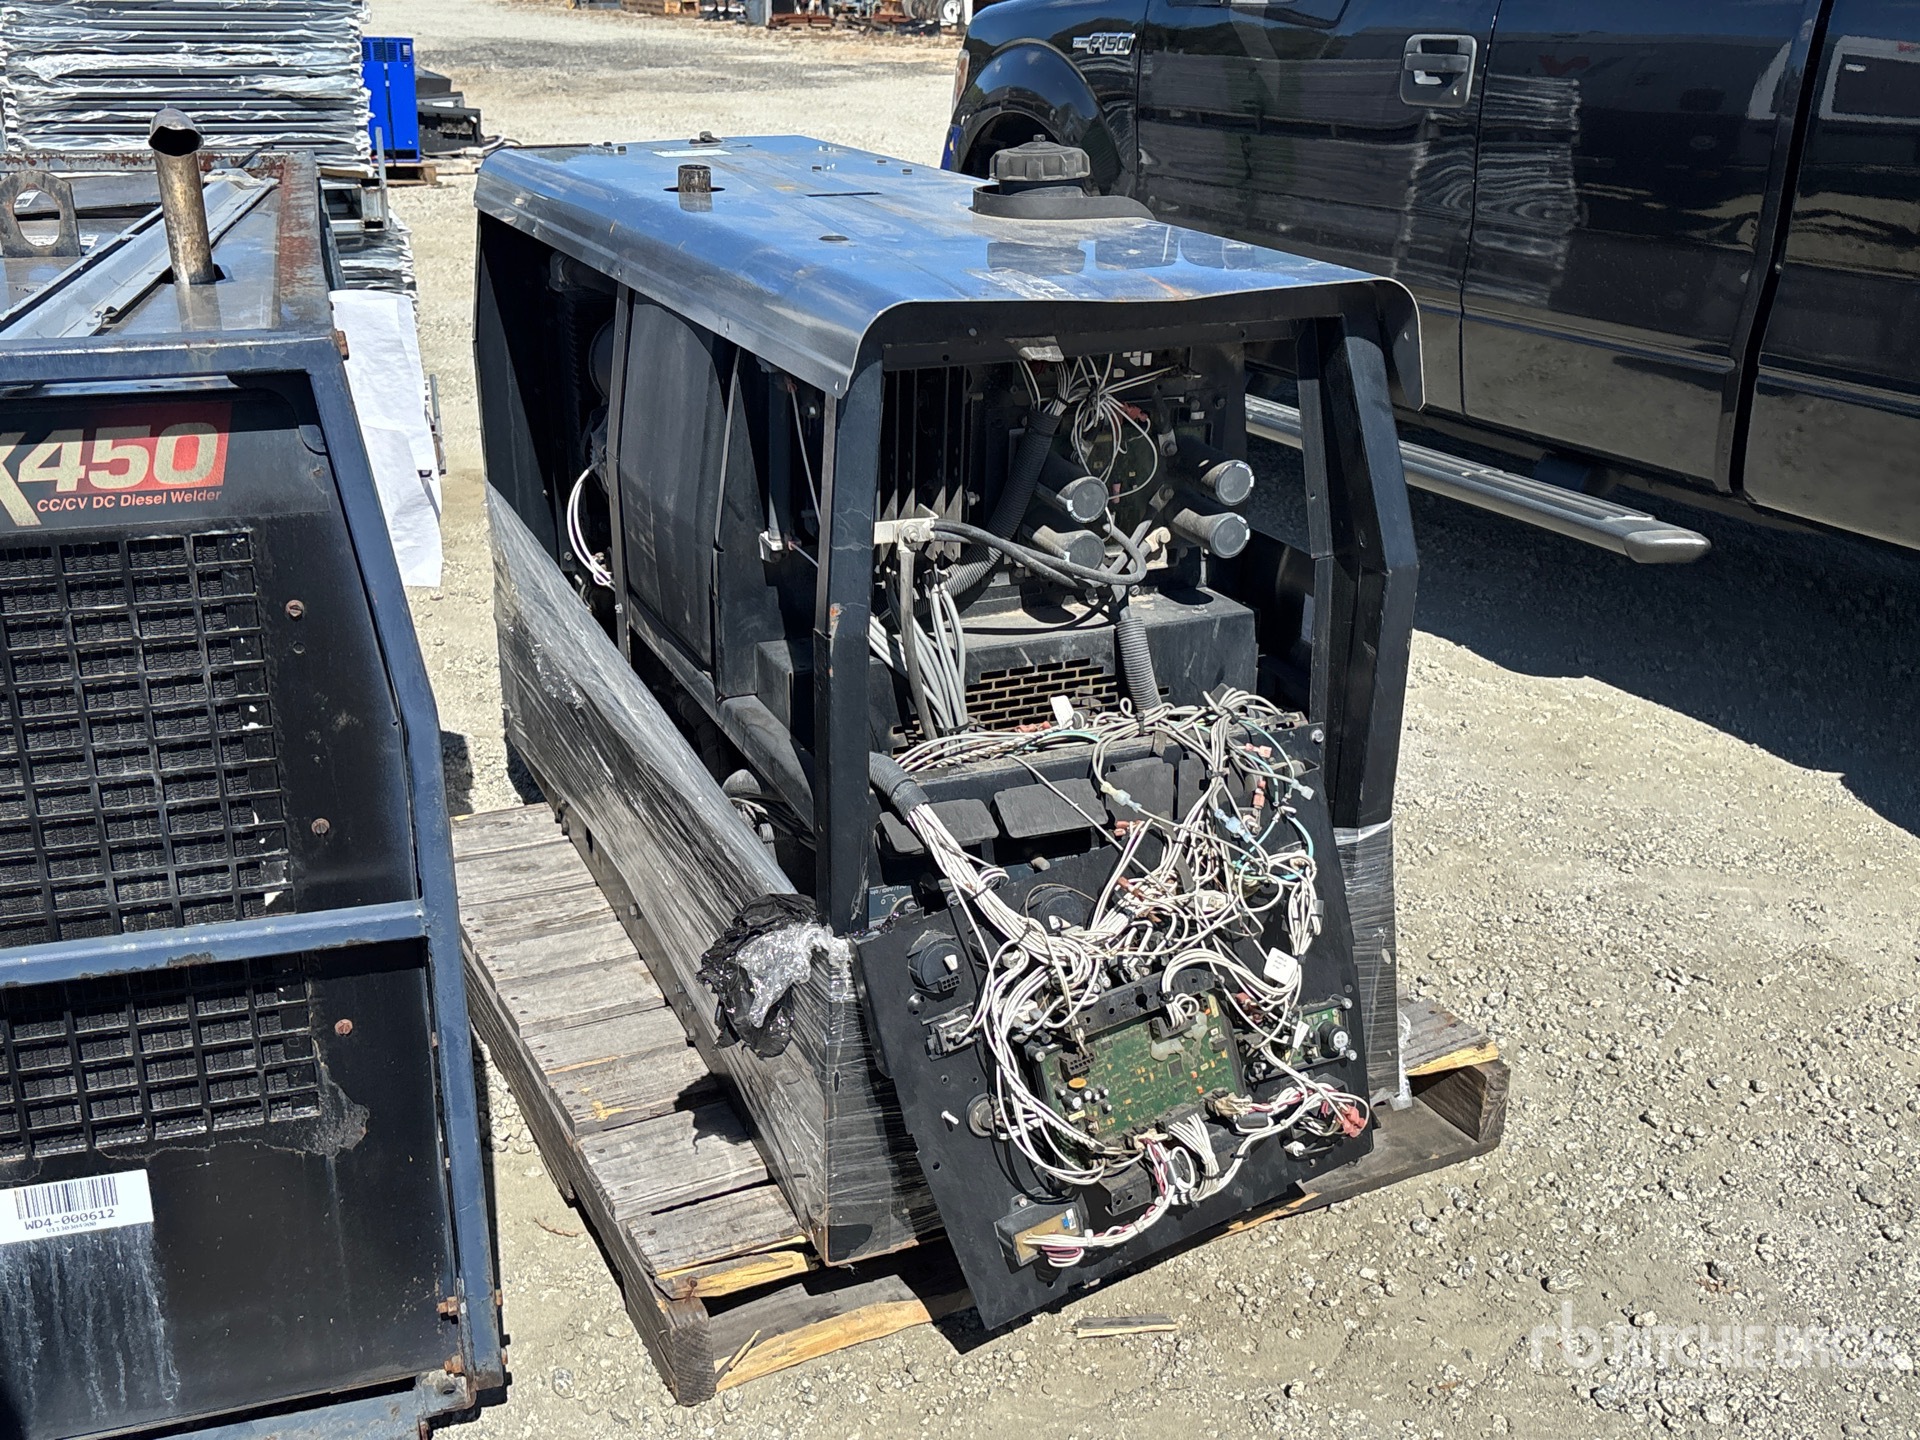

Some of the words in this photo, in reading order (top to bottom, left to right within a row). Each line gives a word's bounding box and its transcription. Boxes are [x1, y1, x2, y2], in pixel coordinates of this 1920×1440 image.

[37, 497, 87, 513] CC/CV
[93, 496, 115, 509] DC
[120, 492, 166, 507] Diesel
[171, 489, 222, 504] Welder
[24, 1208, 116, 1231] WD4-000612
